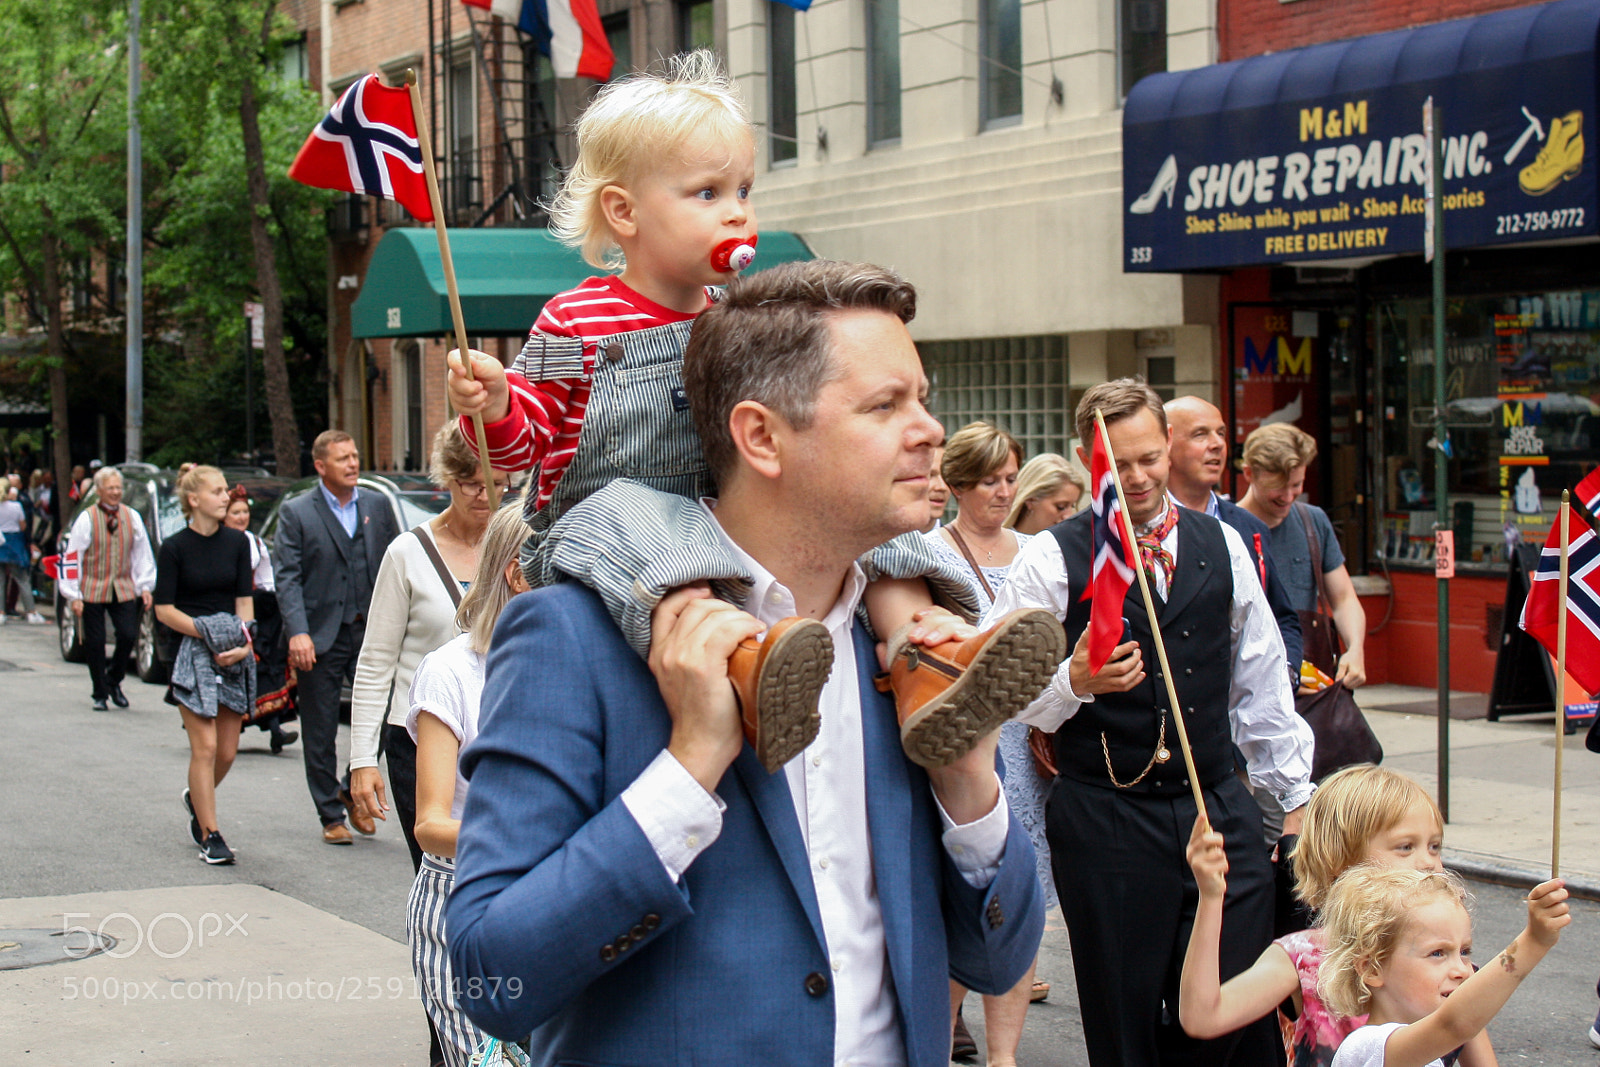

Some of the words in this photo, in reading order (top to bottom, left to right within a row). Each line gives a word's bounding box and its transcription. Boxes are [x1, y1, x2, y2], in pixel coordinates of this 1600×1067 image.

[1300, 100, 1368, 142] M&M
[1184, 154, 1279, 212] SHOE
[1282, 134, 1425, 201] REPAIR
[1186, 215, 1216, 234] Shoe
[1218, 211, 1253, 232] Shine
[1254, 207, 1290, 229] while
[1293, 209, 1317, 231] you
[1320, 201, 1350, 223] wait
[1362, 198, 1398, 219] Shoe
[1401, 187, 1486, 215] Accsories
[1496, 207, 1585, 235] 212-750-9772
[1131, 246, 1152, 264] 353
[1265, 234, 1305, 255] FREE
[1307, 227, 1388, 251] DELIVERY
[1502, 401, 1542, 428] MM
[1503, 438, 1544, 455] REPAIR
[1509, 426, 1537, 440] SHOE
